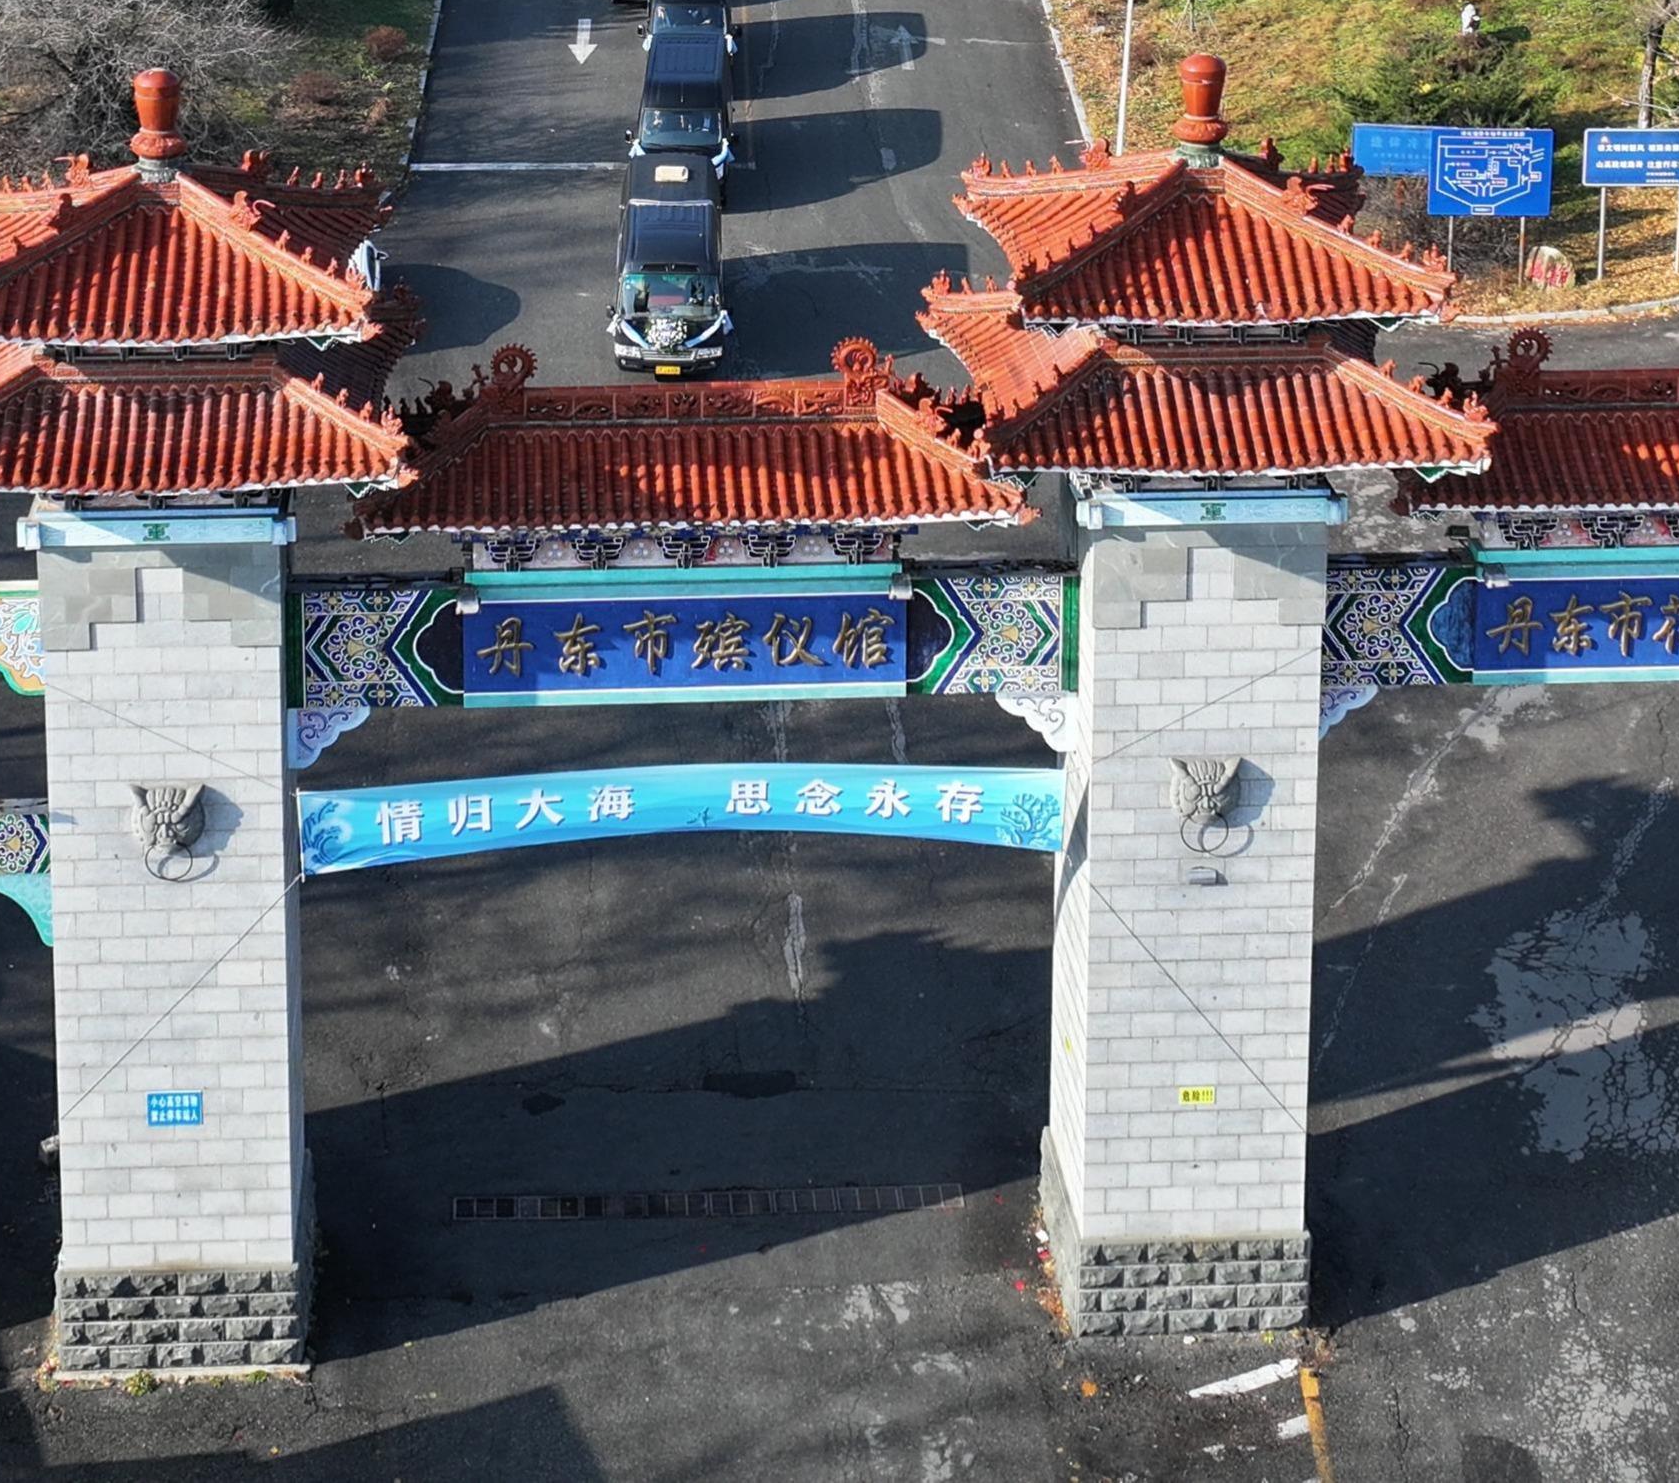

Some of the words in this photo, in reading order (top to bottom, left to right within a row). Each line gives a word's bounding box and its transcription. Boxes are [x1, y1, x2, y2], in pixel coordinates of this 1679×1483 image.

[476, 608, 897, 676] 丹东市殡仪馆
[375, 783, 635, 846] 情归大海
[725, 778, 985, 824] 思念永存
